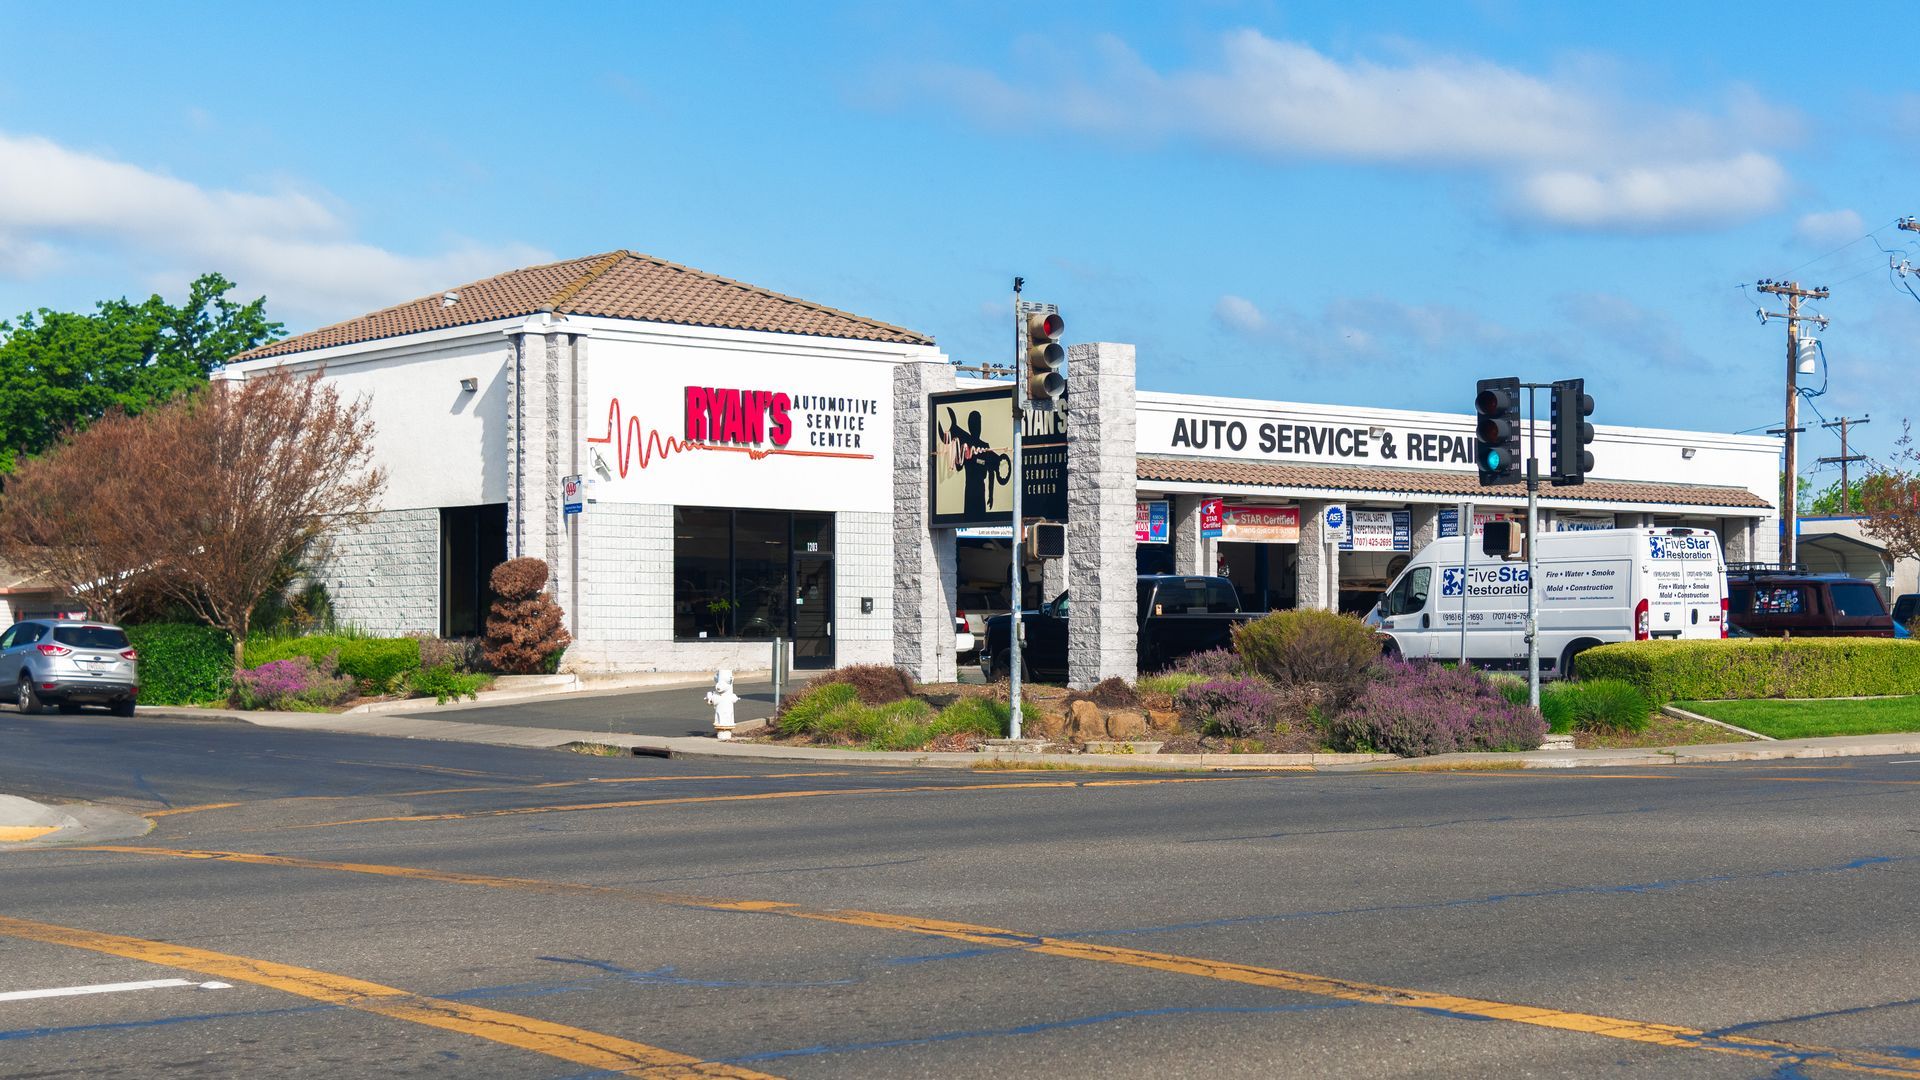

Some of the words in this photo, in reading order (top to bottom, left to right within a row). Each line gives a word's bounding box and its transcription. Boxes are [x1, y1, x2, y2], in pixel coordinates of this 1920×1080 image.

[793, 395, 877, 415] AUTOMOTIVE
[685, 386, 792, 446] RYAN'S
[806, 414, 864, 431] SERVICE
[810, 431, 861, 448] CENTER
[1171, 418, 1247, 451] AUTO
[1259, 423, 1369, 457] SERVICE
[1380, 432, 1397, 459] &
[1024, 453, 1067, 465] UTOMOTIVE
[1025, 469, 1059, 480] SERVICE
[1027, 484, 1056, 495] CENTER
[1241, 514, 1261, 524] STAR
[1264, 514, 1295, 525] Certified
[1328, 513, 1340, 521] ASE
[807, 542, 818, 552] 1203
[1354, 537, 1367, 546] (707)
[1666, 550, 1712, 559] Restoration
[1468, 566, 1529, 583] FiveSta
[1591, 569, 1615, 577] Smoke
[1467, 584, 1528, 596] Restoratio
[1569, 583, 1614, 592] Construction
[1692, 582, 1710, 590] Smoke
[1677, 591, 1710, 599] Construction
